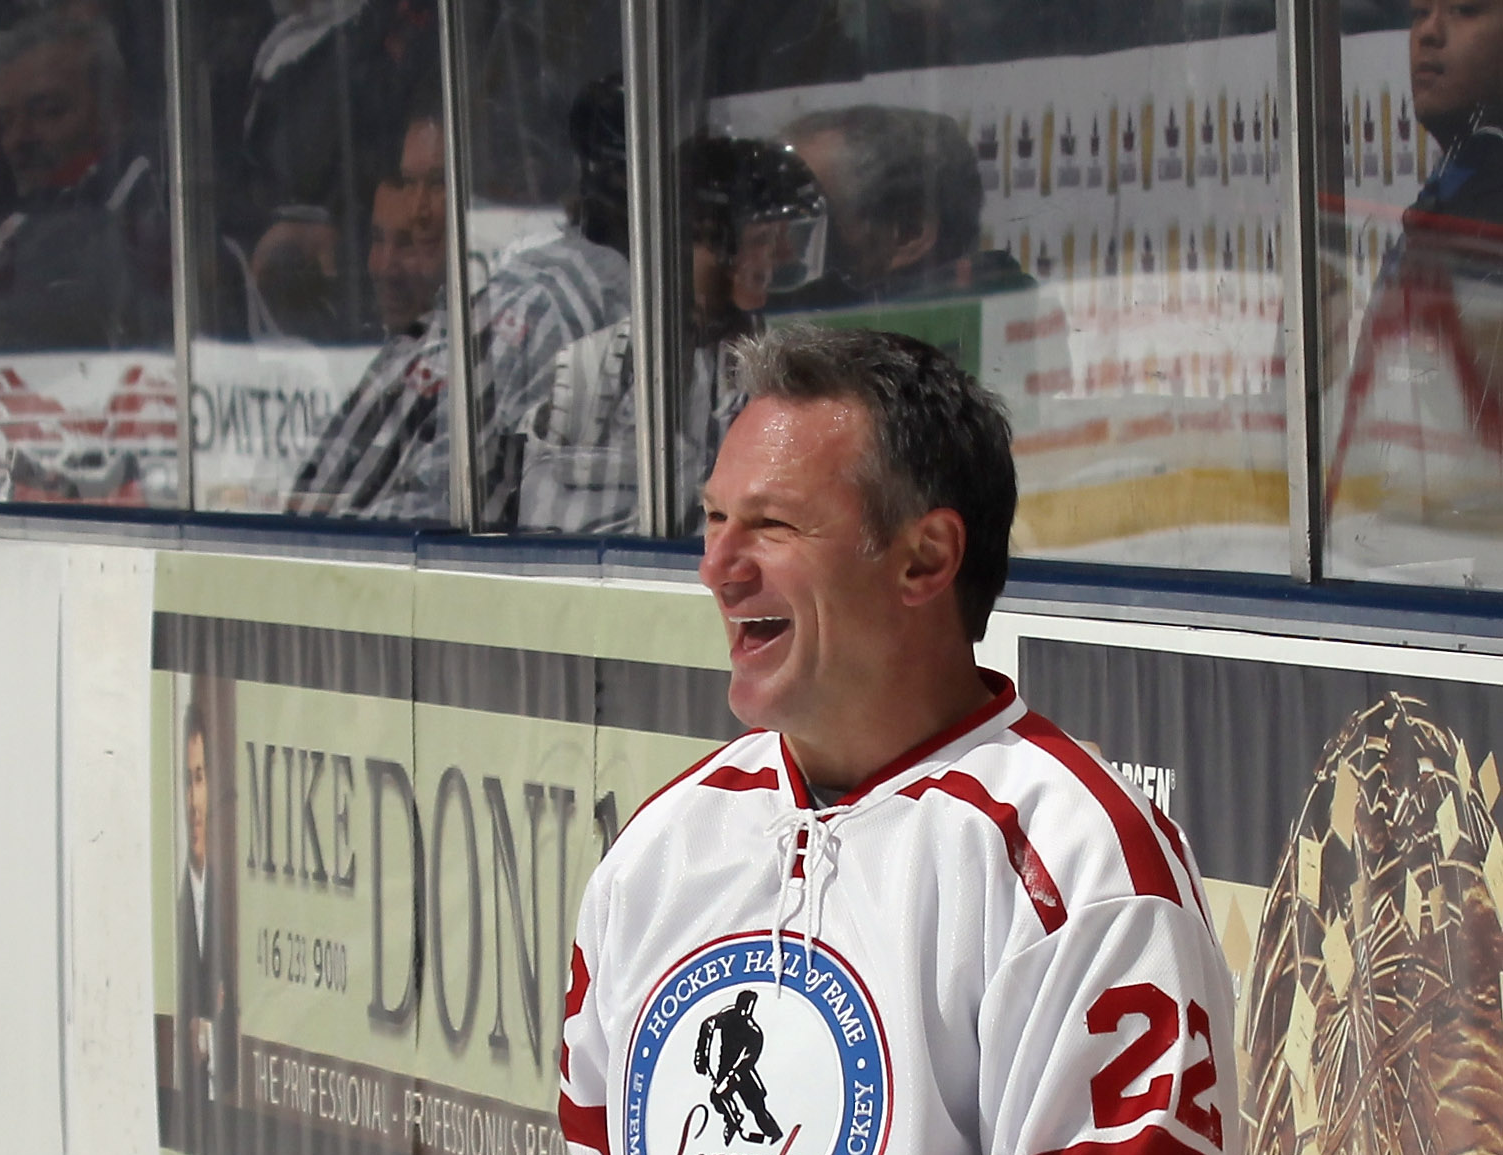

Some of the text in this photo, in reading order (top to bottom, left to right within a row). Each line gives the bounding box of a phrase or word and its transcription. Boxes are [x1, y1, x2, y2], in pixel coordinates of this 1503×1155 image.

[245, 741, 356, 889] MIKE
[648, 950, 867, 1047] HOCKEY HALL of FAME
[253, 1051, 279, 1105] THE
[283, 1058, 389, 1135] PROFESSIONAL
[632, 1071, 644, 1093] LE
[1084, 981, 1225, 1153] 22
